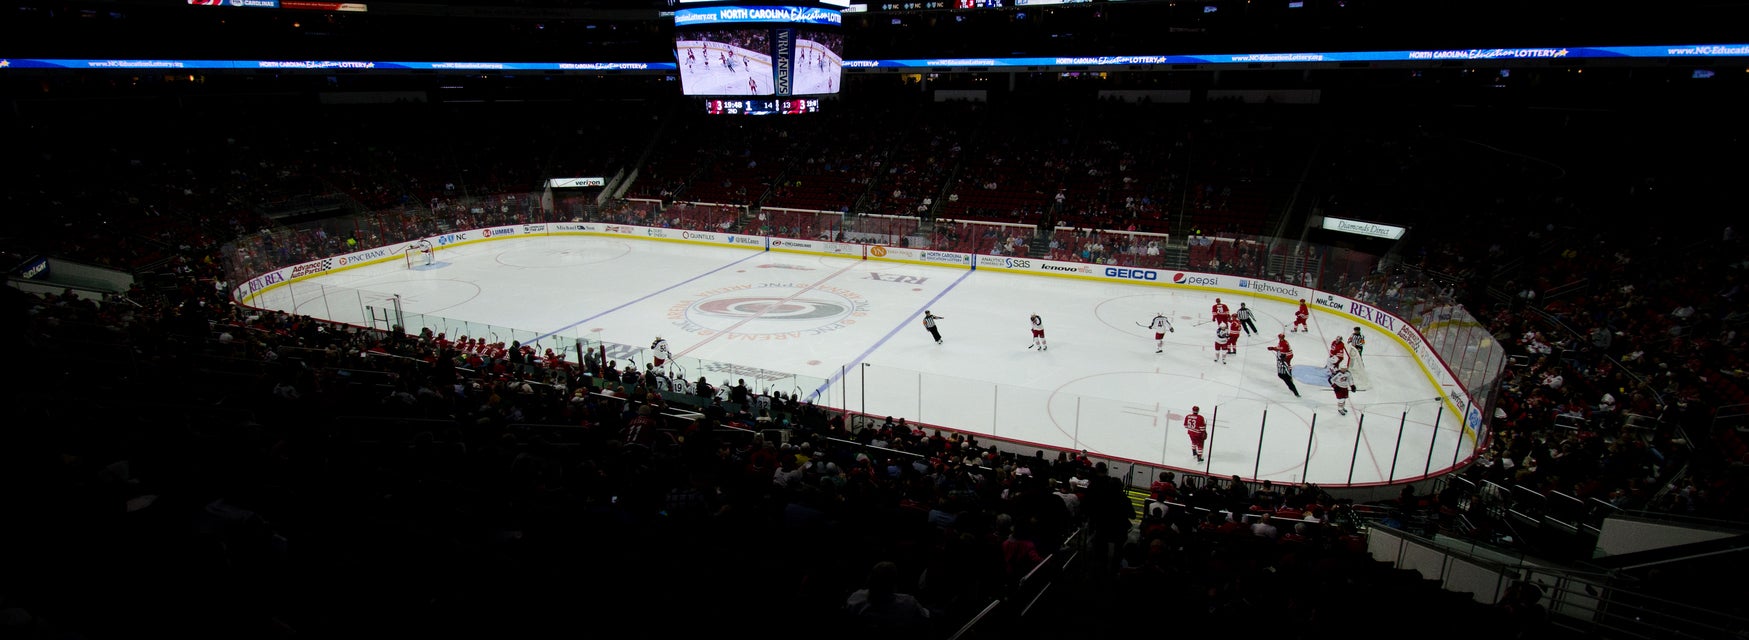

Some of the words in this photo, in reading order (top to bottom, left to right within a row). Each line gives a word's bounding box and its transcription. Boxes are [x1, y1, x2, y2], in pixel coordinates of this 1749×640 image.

[720, 9, 748, 19] NORTH
[749, 9, 790, 19] CAROLINA
[790, 7, 829, 21] Education
[1409, 51, 1432, 59] NORTH
[1433, 51, 1468, 59] CAROLINA
[1468, 50, 1514, 59] Education
[1514, 49, 1555, 58] LOTTERY
[778, 59, 789, 94] NEWS
[716, 101, 722, 111] 3
[745, 101, 752, 111] 1
[800, 100, 805, 110] 3
[492, 227, 515, 236] LUMBER
[1338, 220, 1371, 233] Diamonds
[1370, 225, 1390, 235] Direct
[348, 255, 364, 264] PNC
[365, 250, 386, 260] BANK
[293, 262, 321, 273] Advance
[1013, 259, 1031, 268] sas
[1041, 263, 1077, 273] lenovo
[1105, 267, 1157, 281] GEICO
[250, 279, 264, 292] REX
[264, 271, 285, 288] REX
[1188, 276, 1218, 286] pepsi
[1247, 280, 1298, 297] Highwoods
[1315, 298, 1344, 310] NHL.COM
[1349, 301, 1374, 321] REX
[1374, 310, 1396, 331] REX
[674, 382, 683, 394] 19
[1187, 419, 1197, 430] 53
